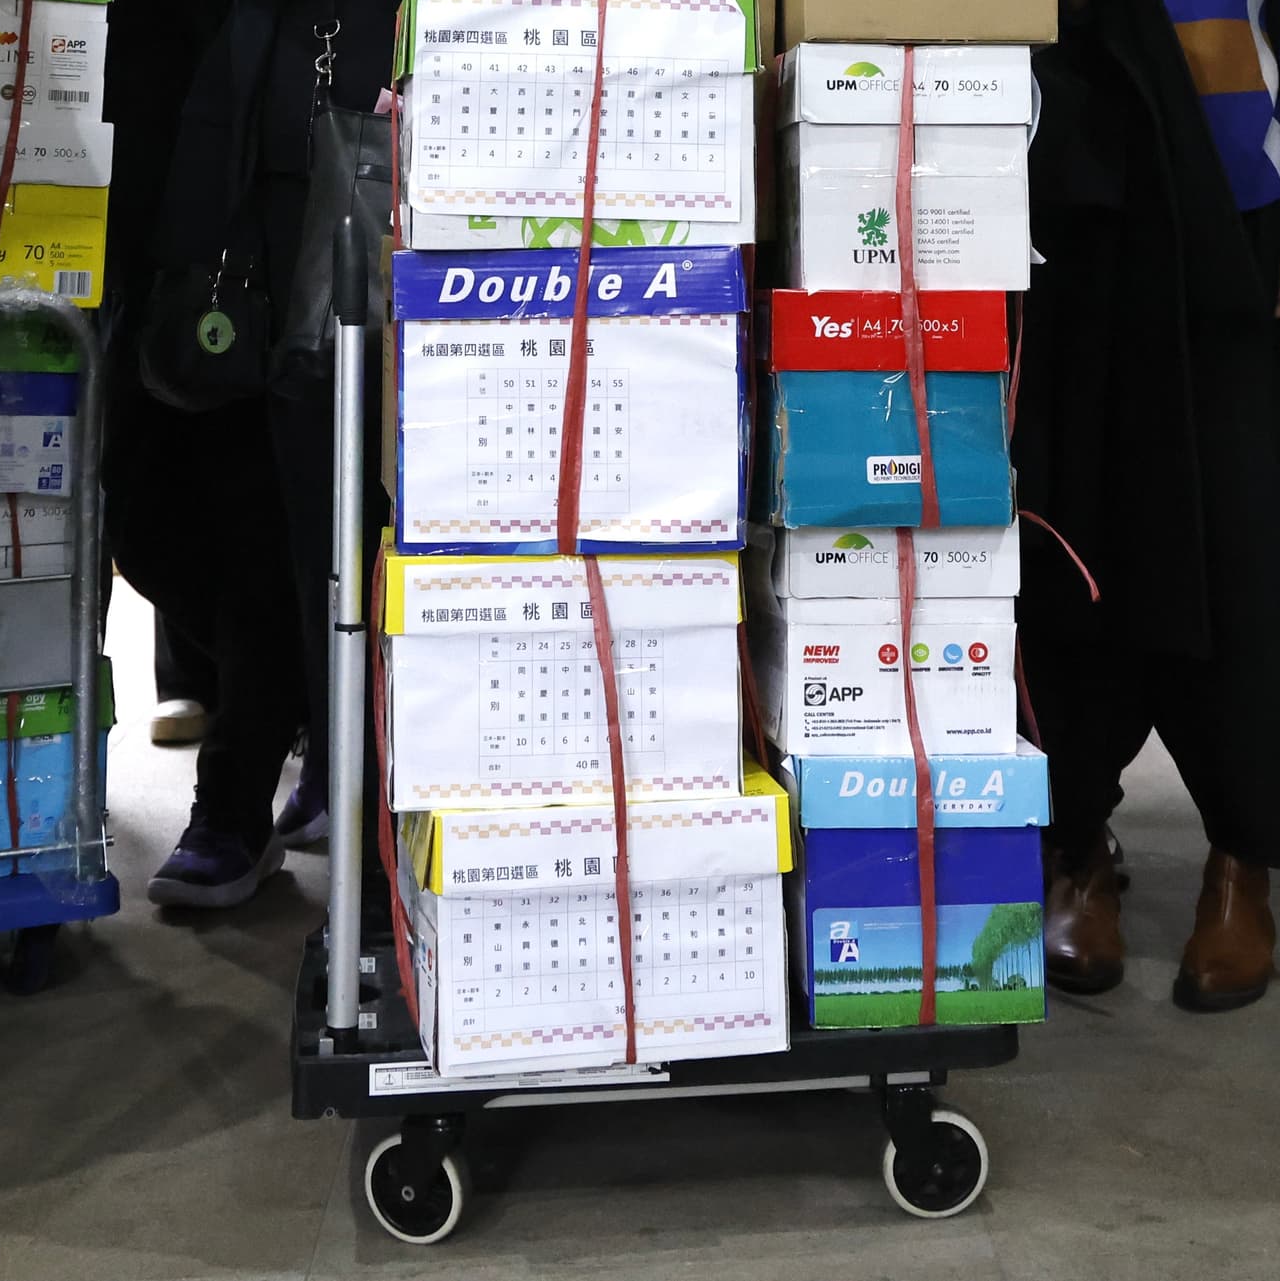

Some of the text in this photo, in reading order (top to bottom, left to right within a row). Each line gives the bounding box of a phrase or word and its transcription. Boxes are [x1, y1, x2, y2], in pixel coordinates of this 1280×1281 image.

[67, 40, 86, 49] APP
[424, 28, 597, 48] 桃園第四選區 桃園區
[461, 63, 584, 74] 40 41 42 43 44
[827, 79, 949, 91] UPM OFFICE 70
[34, 148, 46, 157] 70
[24, 245, 44, 260] 70
[853, 249, 896, 264] UPM
[643, 262, 677, 299] A
[811, 316, 881, 338] Yes A4
[422, 343, 505, 357] 桃園第四選區
[503, 379, 558, 388] 50 51 52
[816, 551, 938, 564] UPM OFFICE 70
[422, 607, 507, 622] 桃園第四選區
[516, 641, 592, 651] 23 24 25 26
[803, 645, 840, 657] NEW!
[829, 687, 864, 701] APP
[576, 760, 589, 769] 40
[980, 770, 1004, 796] A
[453, 864, 539, 884] 桃園第四選區
[520, 893, 588, 907] 31 32 33
